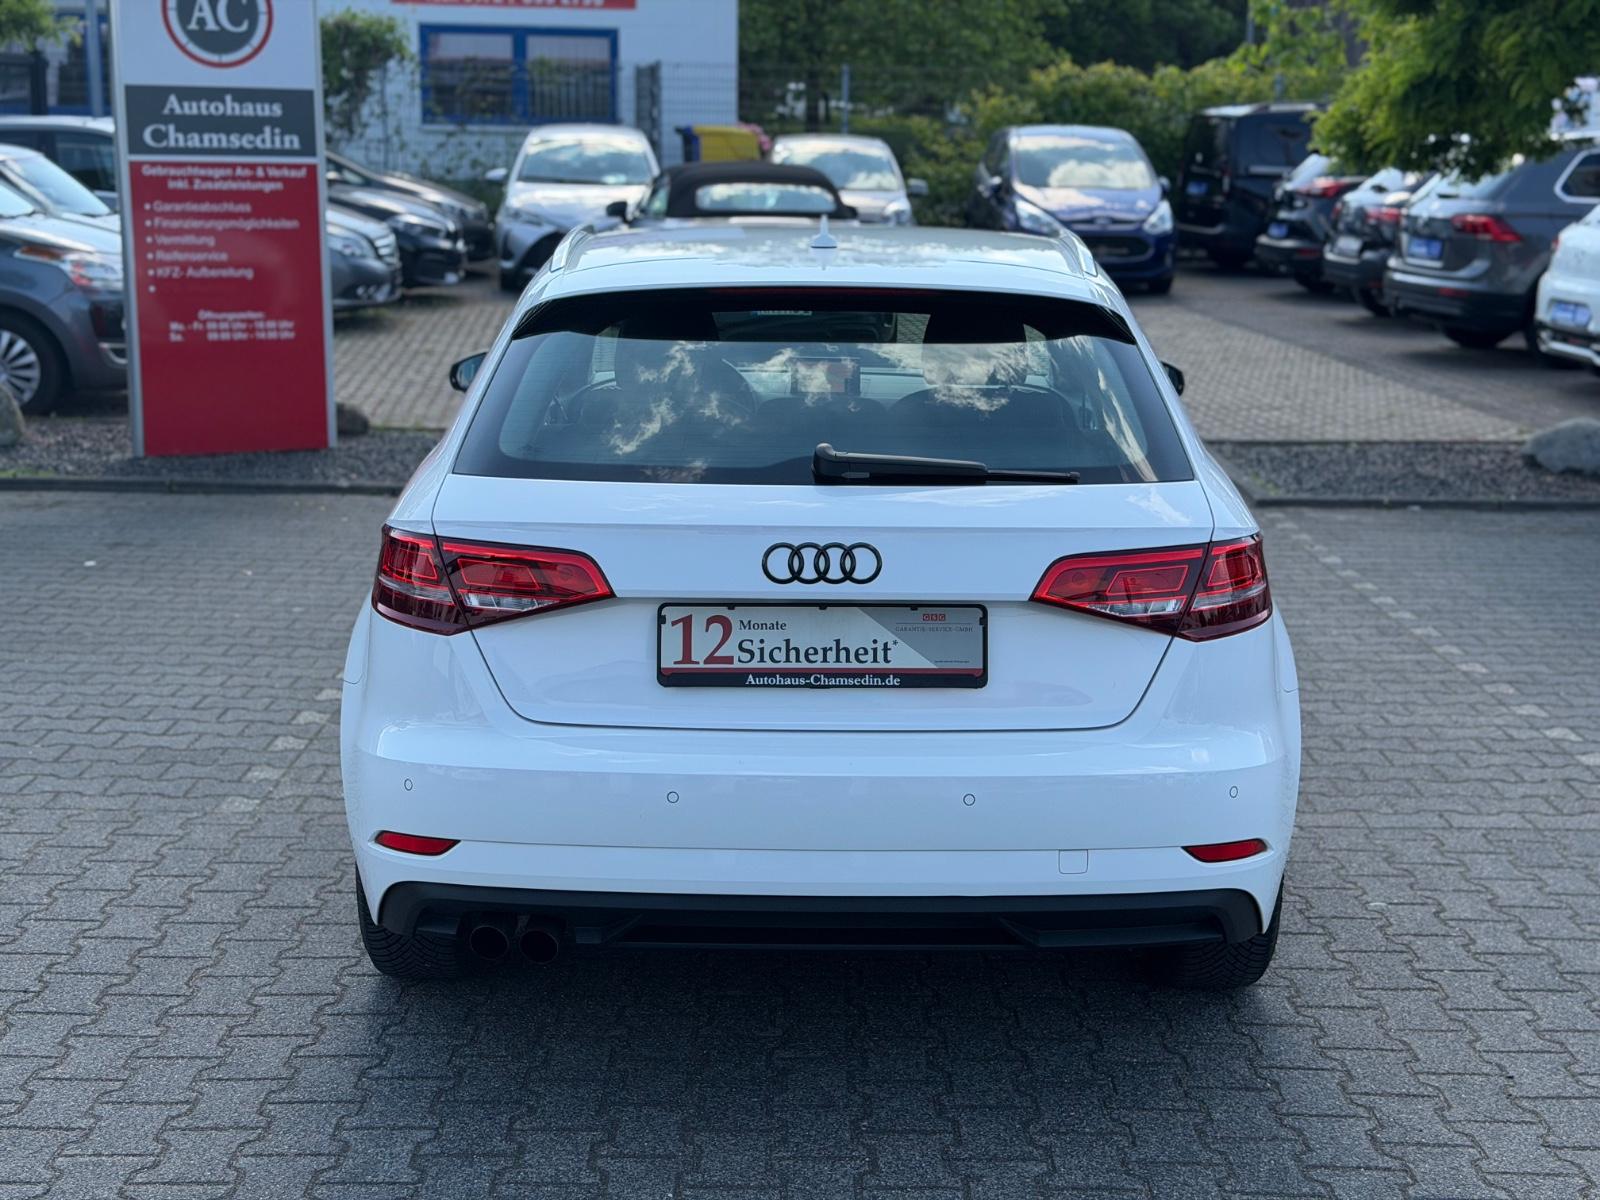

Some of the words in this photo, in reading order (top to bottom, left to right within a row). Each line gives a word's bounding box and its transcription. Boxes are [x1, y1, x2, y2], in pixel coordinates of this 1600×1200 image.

[187, 0, 250, 33] AC
[162, 93, 283, 118] Autohaus
[143, 124, 300, 150] Chamsedin
[738, 620, 787, 631] Monate
[671, 614, 735, 665] 12
[745, 673, 901, 686] Autohaus-Chamsedin.de
